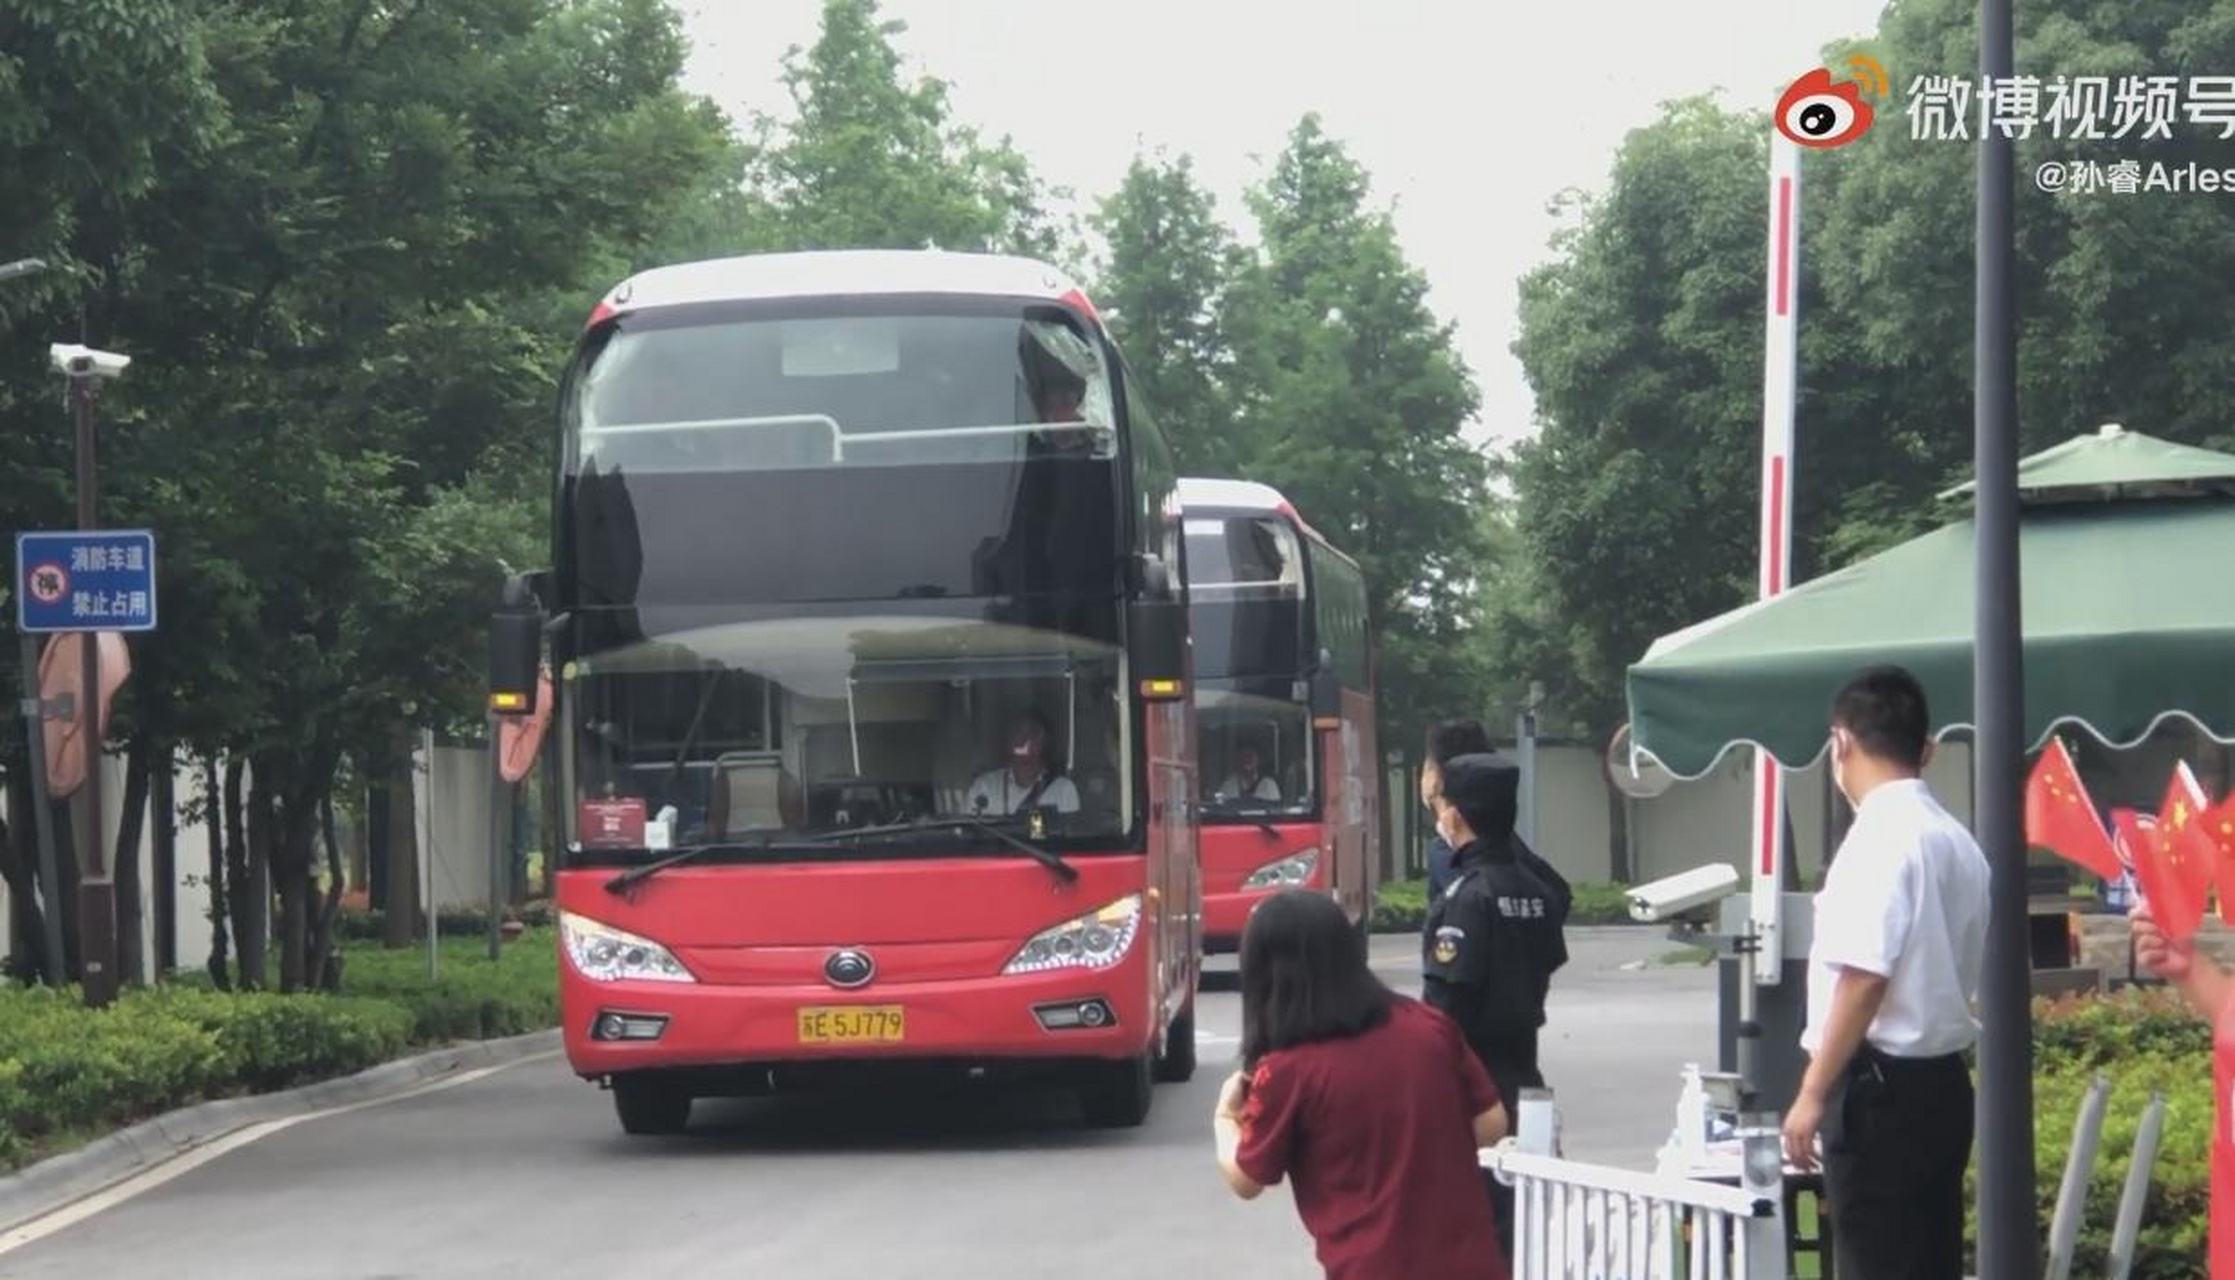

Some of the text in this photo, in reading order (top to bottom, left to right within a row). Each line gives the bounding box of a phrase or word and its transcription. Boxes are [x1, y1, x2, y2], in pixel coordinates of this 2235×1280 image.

[71, 546, 144, 571] 消防车道
[72, 590, 147, 617] 禁止占用
